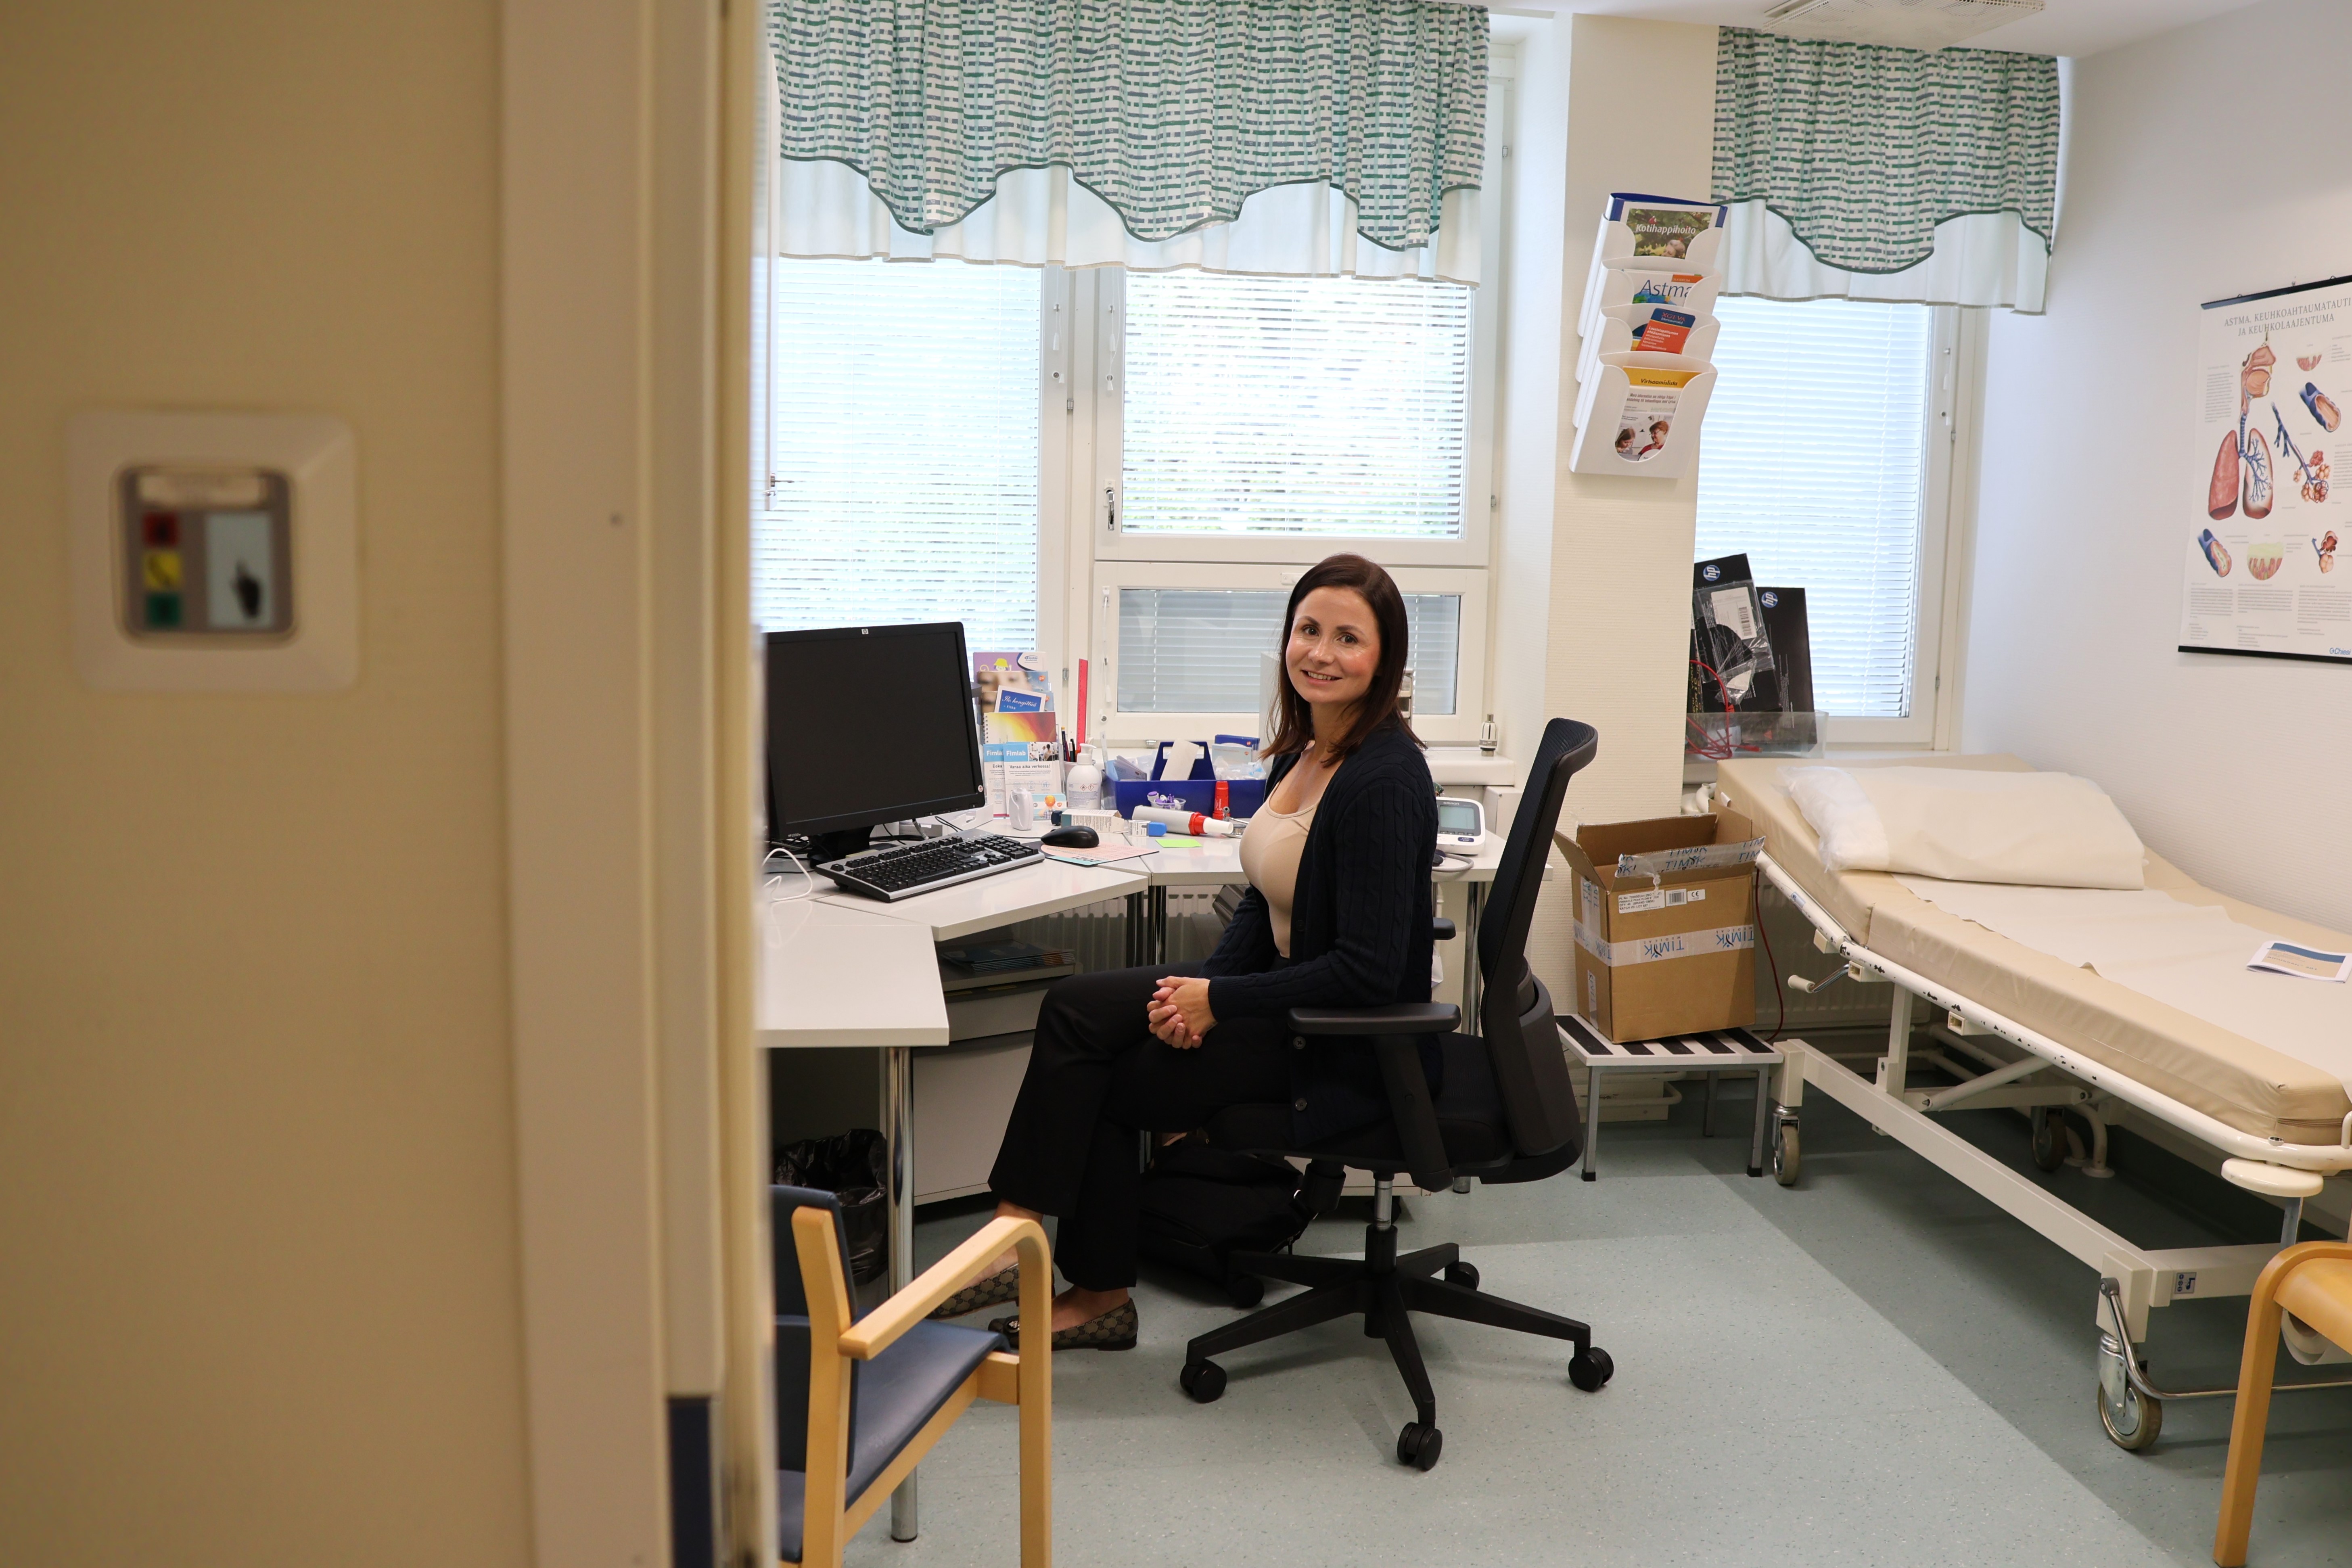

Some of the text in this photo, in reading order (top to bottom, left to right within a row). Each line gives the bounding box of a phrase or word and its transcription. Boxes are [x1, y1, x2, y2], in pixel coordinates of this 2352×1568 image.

[1636, 224, 1696, 235] Kotihappihoito
[2224, 297, 2351, 326] ASTMA, KEUHKOAHTAUMATAUTI
[2238, 313, 2335, 336] JA KEUHKOLAAJENTUMA
[1704, 567, 1721, 579] hp
[1762, 593, 1778, 606] hp
[1012, 696, 1037, 707] hengittää
